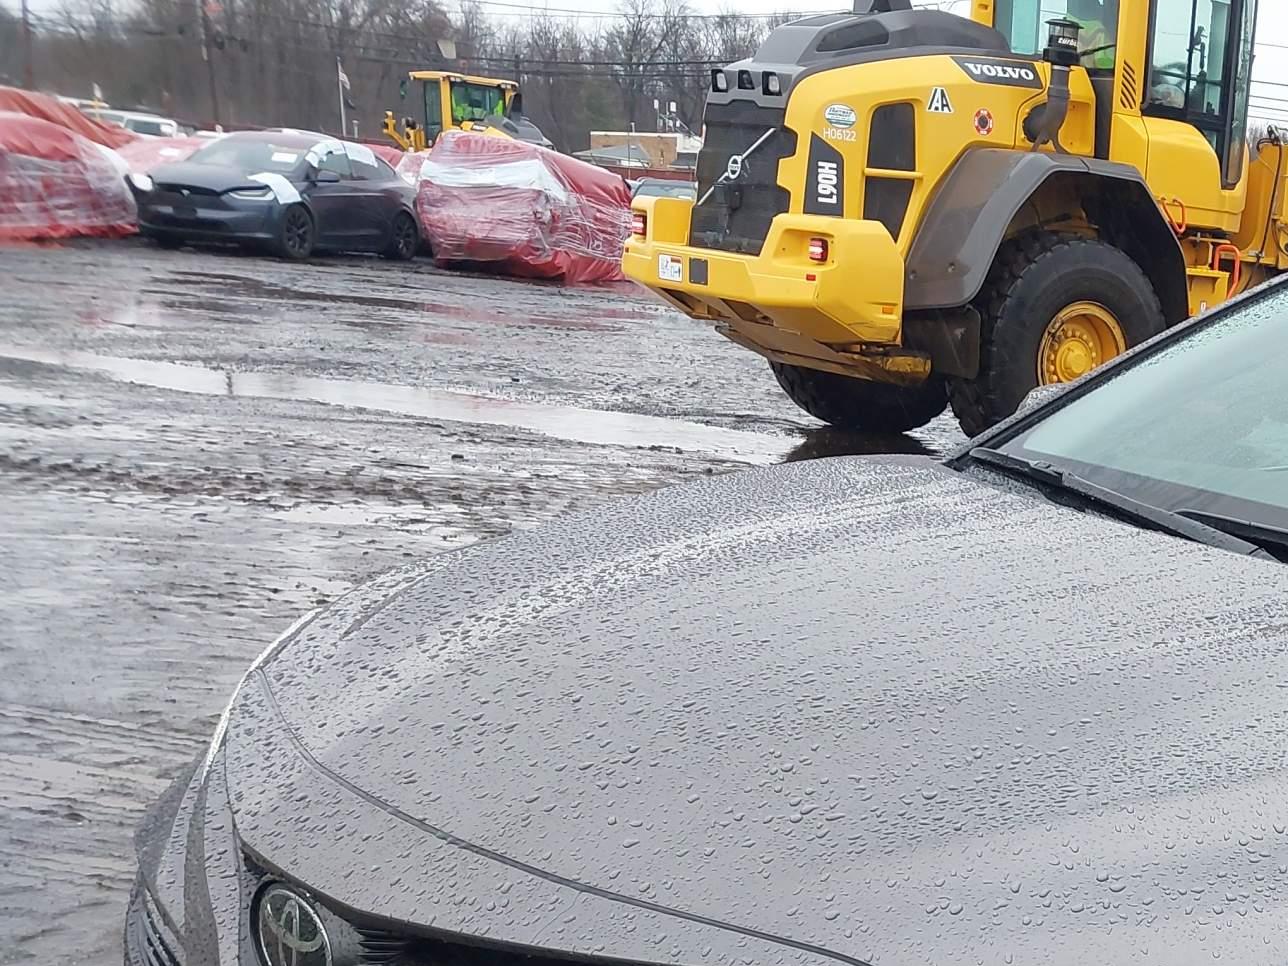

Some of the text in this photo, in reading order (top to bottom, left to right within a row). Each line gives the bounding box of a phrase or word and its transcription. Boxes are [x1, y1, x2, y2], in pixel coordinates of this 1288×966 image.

[964, 62, 1034, 81] VOLVO
[823, 128, 856, 141] H06122
[817, 161, 837, 204] L90H
